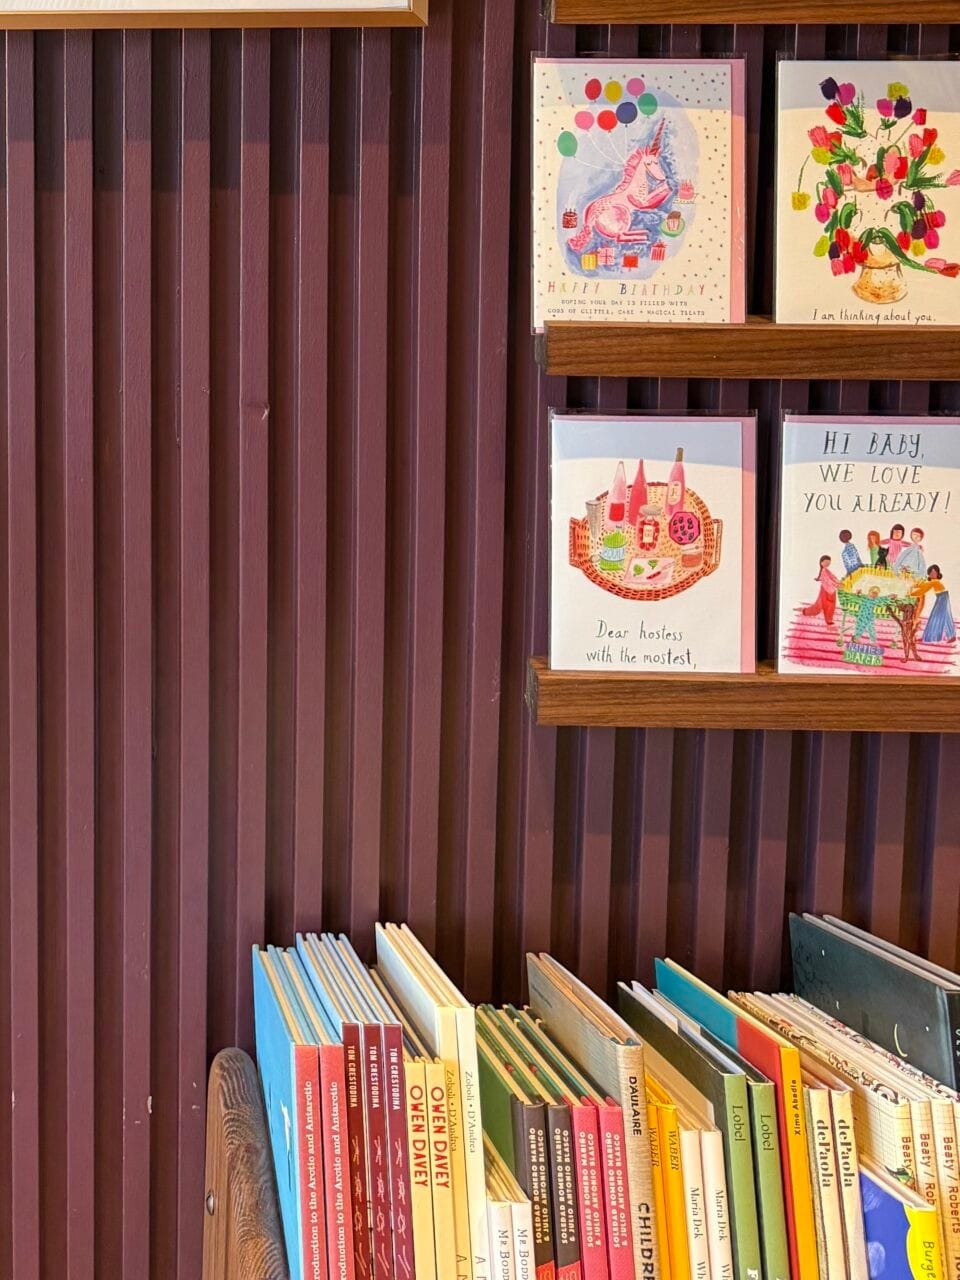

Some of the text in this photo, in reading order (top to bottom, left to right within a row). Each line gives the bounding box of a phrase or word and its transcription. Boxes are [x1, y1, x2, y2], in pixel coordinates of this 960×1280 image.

[812, 308, 818, 320] I
[840, 308, 880, 325] thinking
[883, 309, 911, 320] about
[915, 313, 937, 325] you.
[822, 430, 925, 459] HI BABY,
[819, 463, 923, 484] WE LOVE
[803, 493, 842, 513] YOU
[595, 619, 683, 641] Dear hostess
[586, 644, 613, 663] with
[620, 646, 637, 663] the
[347, 1045, 358, 1108] TOM CRESTODINA
[369, 1046, 380, 1109] TOM CRESTODINA
[389, 1047, 400, 1110] TOM CRESTODINA
[465, 1071, 476, 1153] Zoboli D'Andrea
[628, 1076, 642, 1136] D'AULAIRE
[732, 1105, 746, 1142] Lobel
[793, 1111, 801, 1135] Ximo
[306, 1134, 315, 1154] and
[332, 1135, 341, 1155] and
[409, 1085, 428, 1187] OWEN DAVEY
[431, 1086, 450, 1189] OWEN DAVEY
[537, 1129, 545, 1162] BLASCO
[587, 1133, 595, 1166] BLASCO
[613, 1134, 622, 1167] BLASCO
[648, 1127, 660, 1167] WABER
[668, 1130, 679, 1170] WABER
[760, 1114, 774, 1151] Lobel
[920, 1133, 931, 1168] Beaty
[816, 1120, 833, 1187] dePaola
[838, 1119, 855, 1188] dePaola
[901, 1136, 912, 1171] Beaty
[309, 1192, 317, 1210] the
[335, 1192, 344, 1210] the
[532, 1165, 540, 1201] ROMERO
[539, 1165, 547, 1205] ANTONIO
[557, 1165, 565, 1201] ROMERO
[565, 1165, 573, 1205] ANTONIO
[582, 1169, 590, 1205] ROMERO
[590, 1169, 598, 1209] ANTONIO
[608, 1169, 617, 1206] ROMERO
[616, 1169, 625, 1209] ANTONIO
[942, 1137, 960, 1234] Beaty Roberts
[310, 1211, 318, 1223] to
[336, 1212, 344, 1224] to
[534, 1205, 542, 1243] SOLEDAD
[559, 1205, 568, 1244] SOLEDAD
[584, 1208, 593, 1248] SOLEDAD
[593, 1212, 601, 1236] JULIO
[611, 1209, 620, 1248] SOLEDAD
[619, 1212, 627, 1237] JULIO
[690, 1187, 703, 1239] Maria Dek
[715, 1189, 728, 1241] Maria Dek
